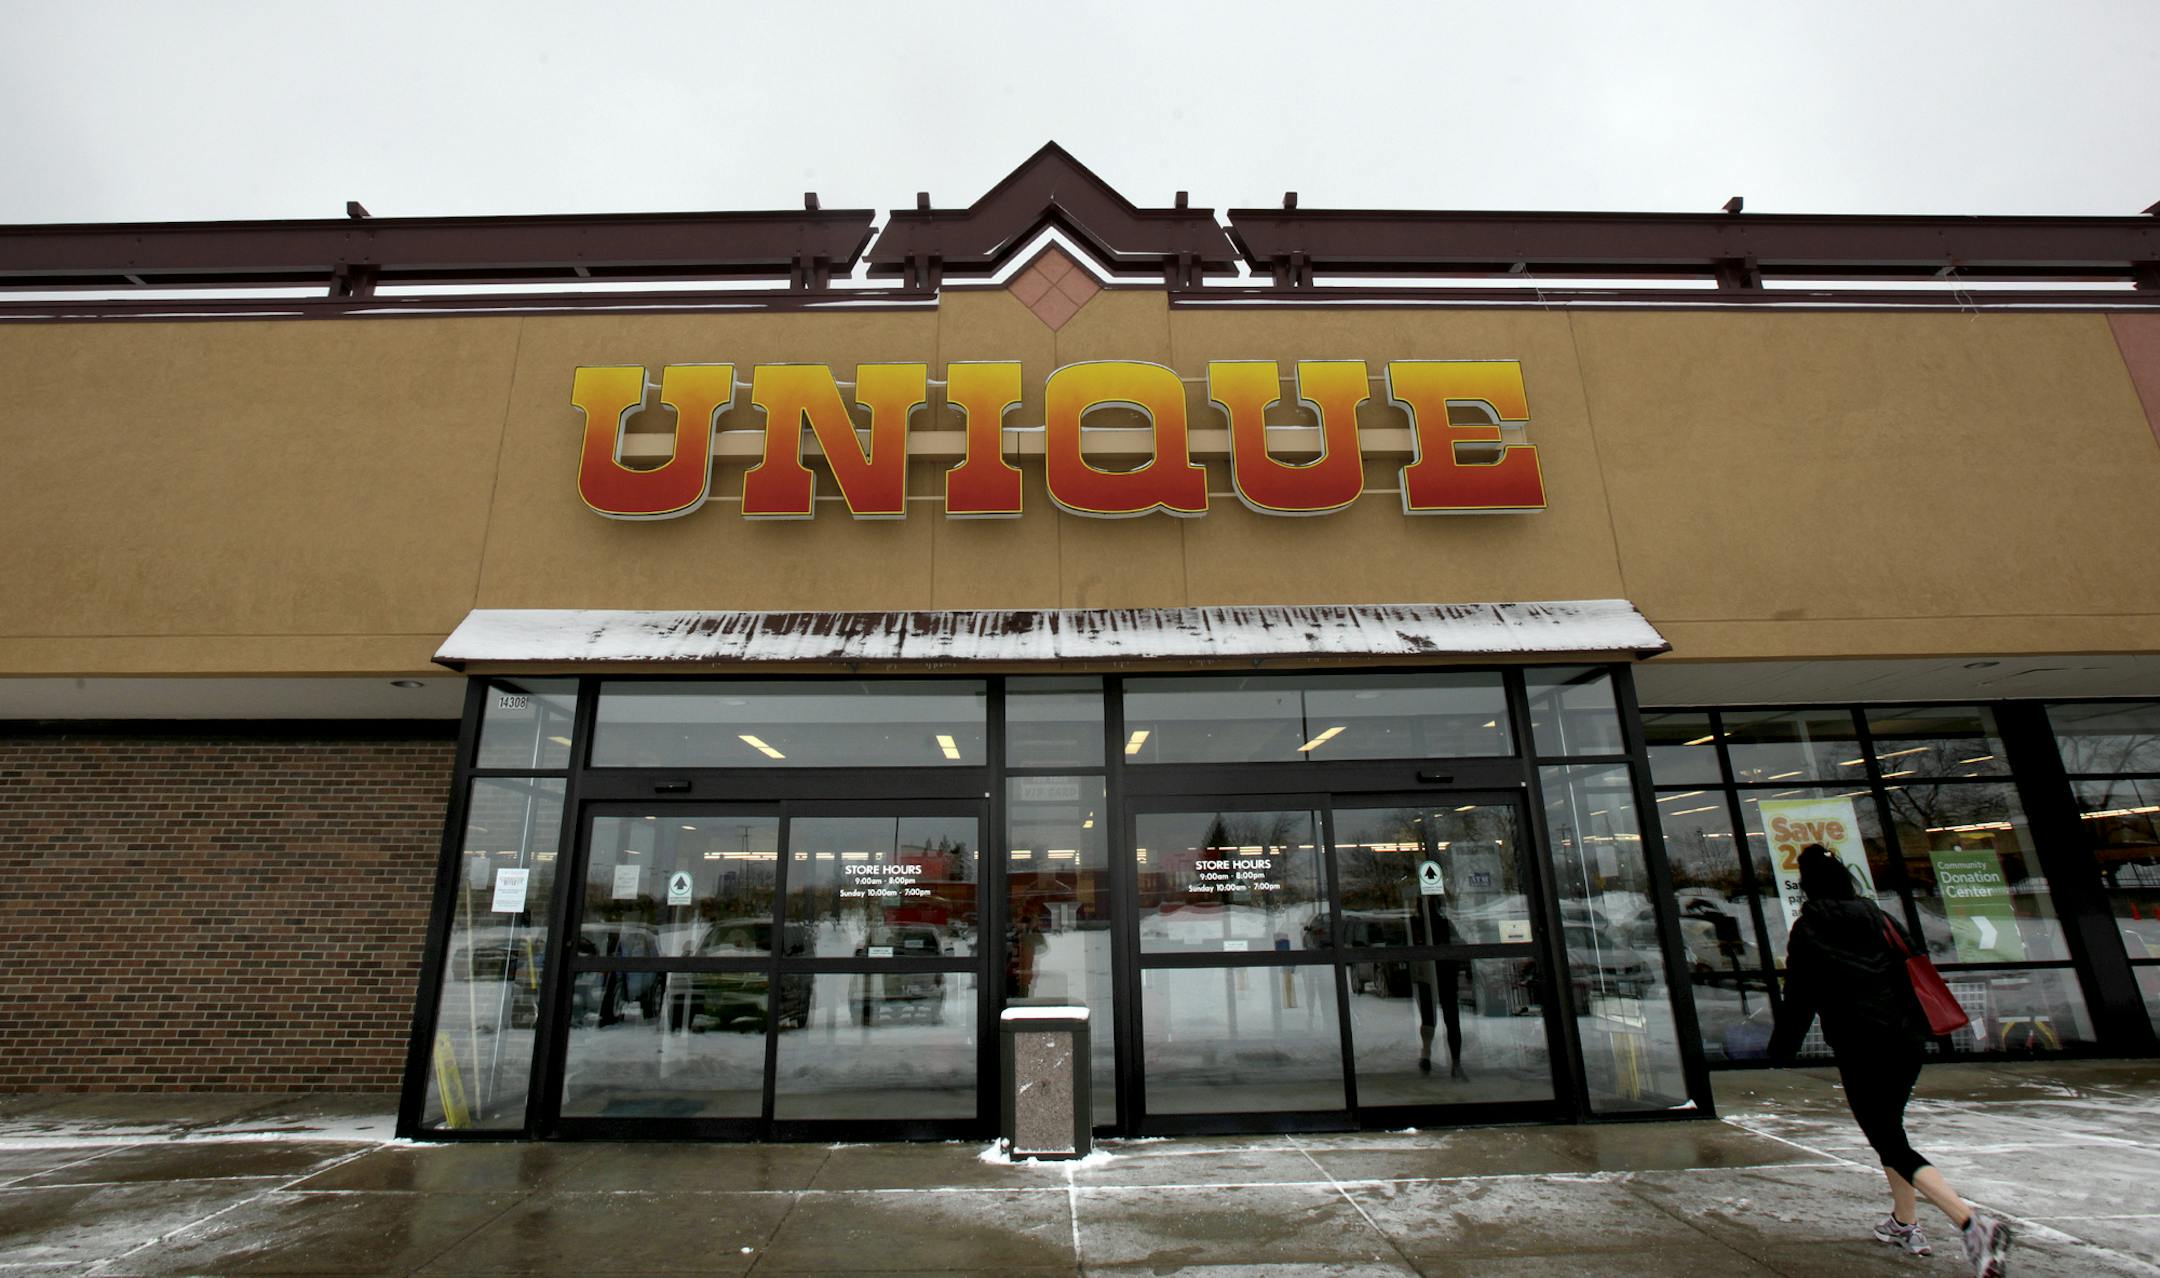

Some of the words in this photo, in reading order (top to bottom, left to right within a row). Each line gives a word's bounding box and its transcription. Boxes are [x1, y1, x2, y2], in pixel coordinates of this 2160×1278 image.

[572, 361, 1548, 520] UNIQUE
[499, 695, 527, 709] 14308
[1770, 815, 1847, 843] Save
[845, 865, 880, 874] STORE
[883, 865, 921, 874] HOURS
[1195, 860, 1230, 870] STORE
[1232, 860, 1271, 869] HOURS
[1937, 861, 1987, 871] Community
[855, 877, 882, 885] 9:00am
[1235, 872, 1265, 880] 8:00pm
[1940, 871, 2000, 884] Donation
[1188, 885, 1214, 893] Sunday
[1216, 884, 1247, 892] 10:00am
[1253, 883, 1280, 891] 7:00pm
[1945, 885, 1994, 898] Center
[840, 889, 865, 898] Sunday
